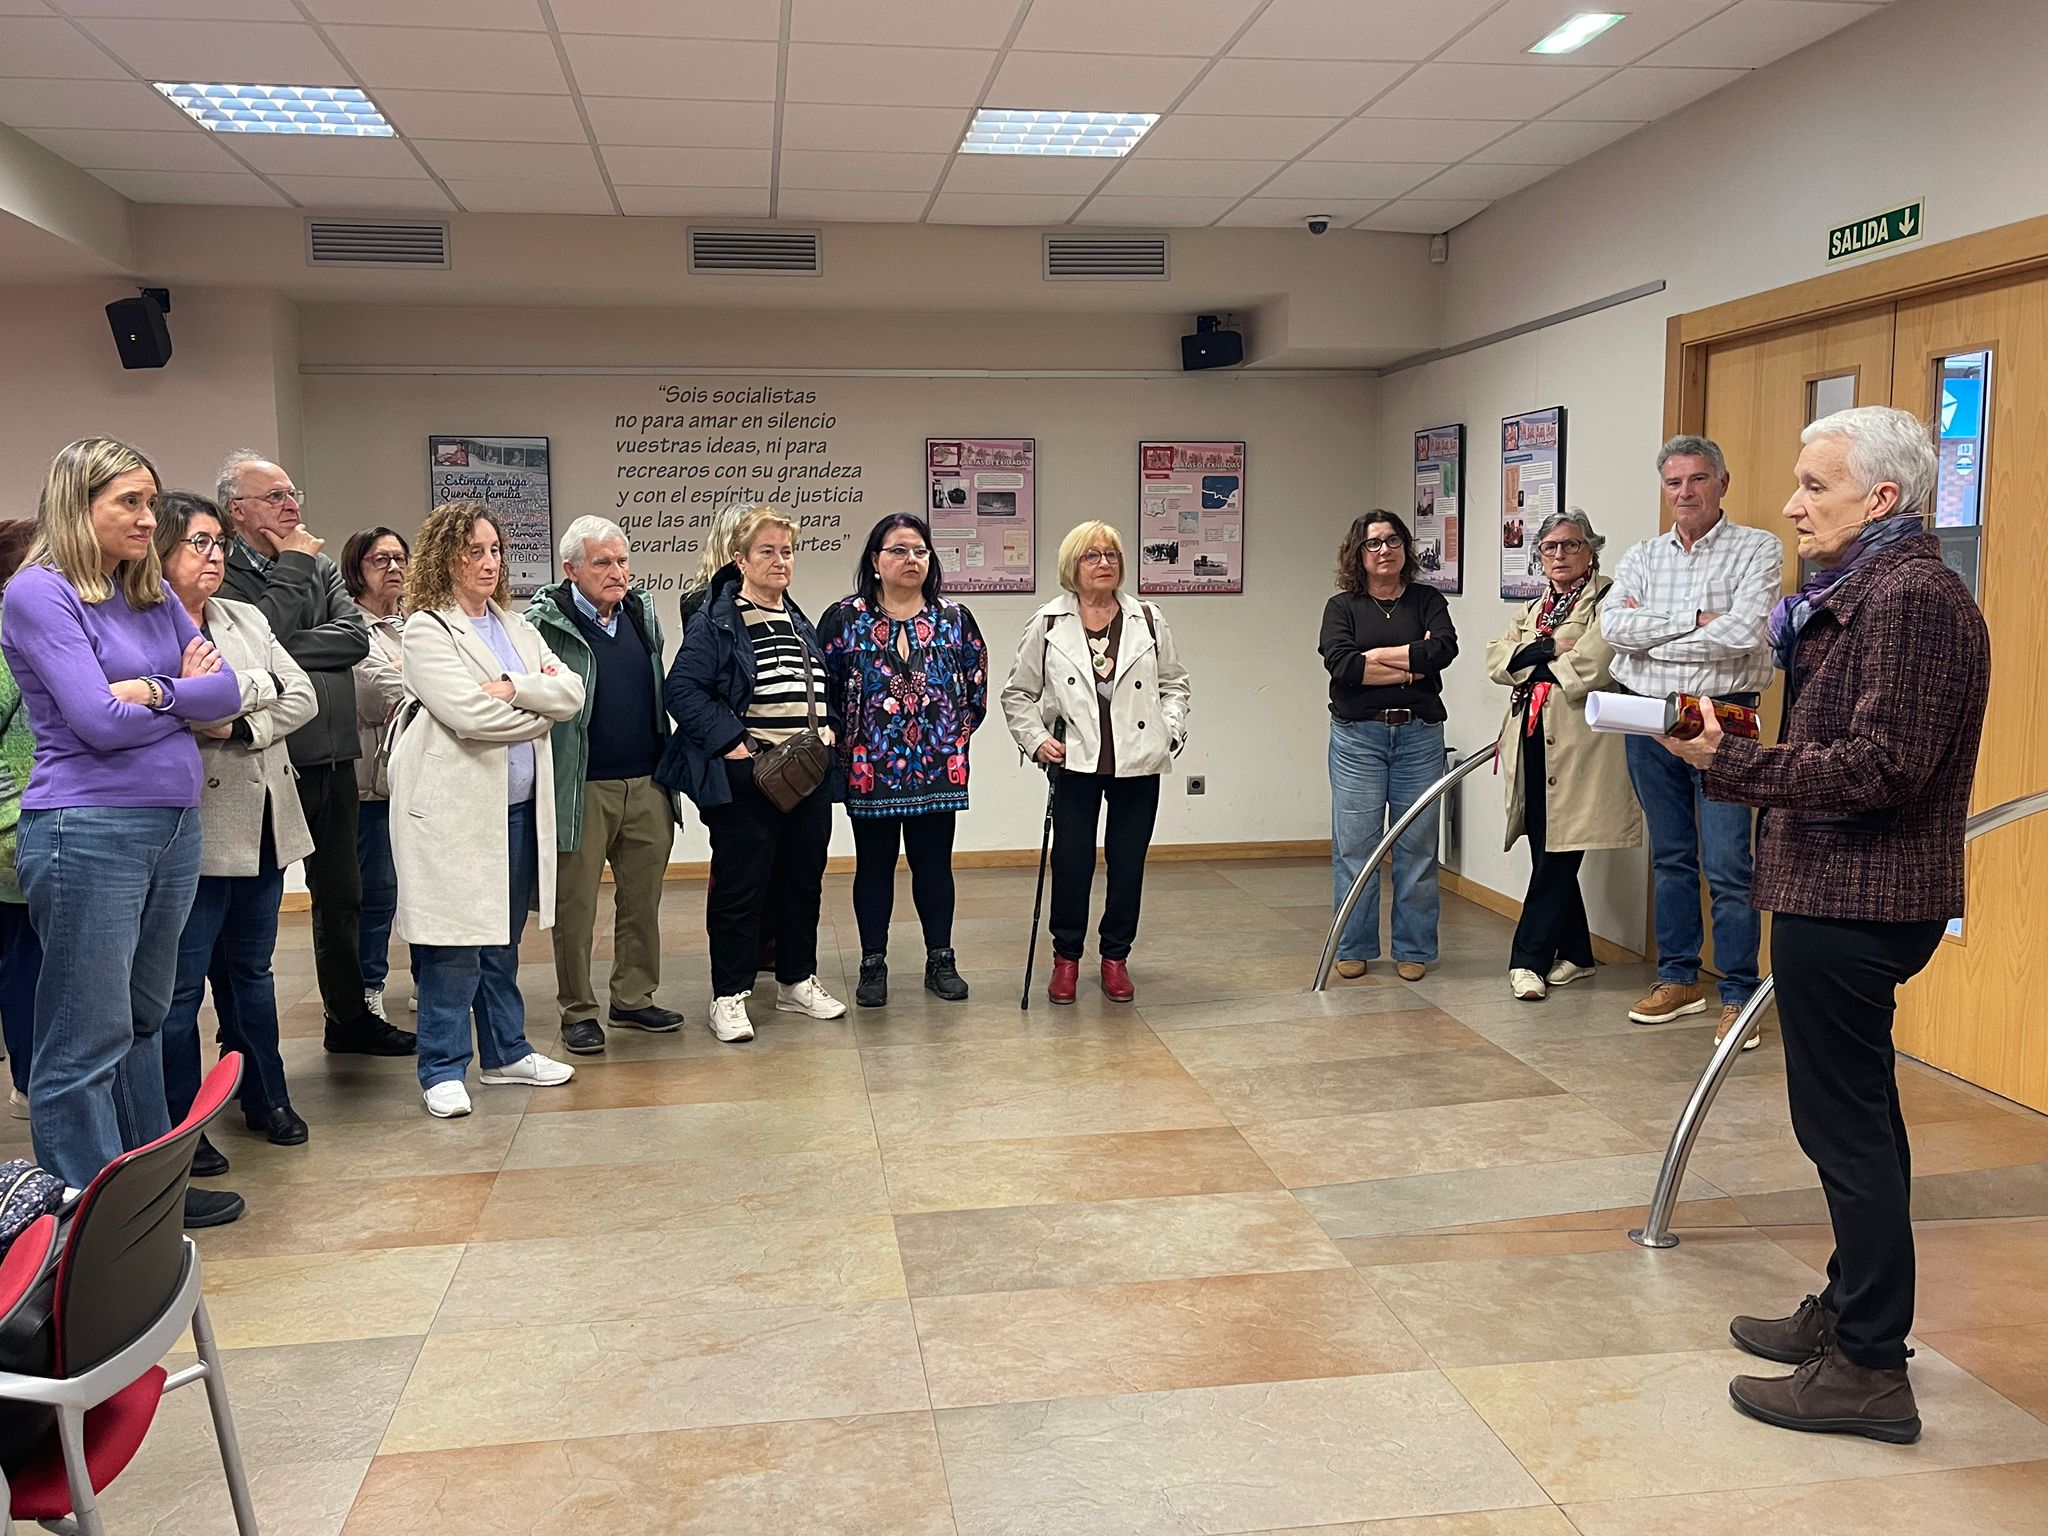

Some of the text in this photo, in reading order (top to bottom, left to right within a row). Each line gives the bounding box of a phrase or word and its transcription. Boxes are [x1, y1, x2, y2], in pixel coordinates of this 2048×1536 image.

[1831, 217, 1889, 256] SALIDA
[658, 385, 816, 404] “Sois socialistas
[615, 411, 837, 435] no para amar en silencio
[616, 435, 827, 460] vuestras ideas, ni para
[444, 474, 528, 491] Estimada amiga
[617, 461, 862, 483] recrearos con su grandeza
[440, 486, 484, 502] Querida
[485, 485, 522, 504] familia
[616, 485, 863, 510] y con el espíritu de justicia
[619, 514, 653, 535] que
[657, 510, 685, 528] las
[799, 514, 840, 534] para
[628, 534, 850, 553] evarlas artes”
